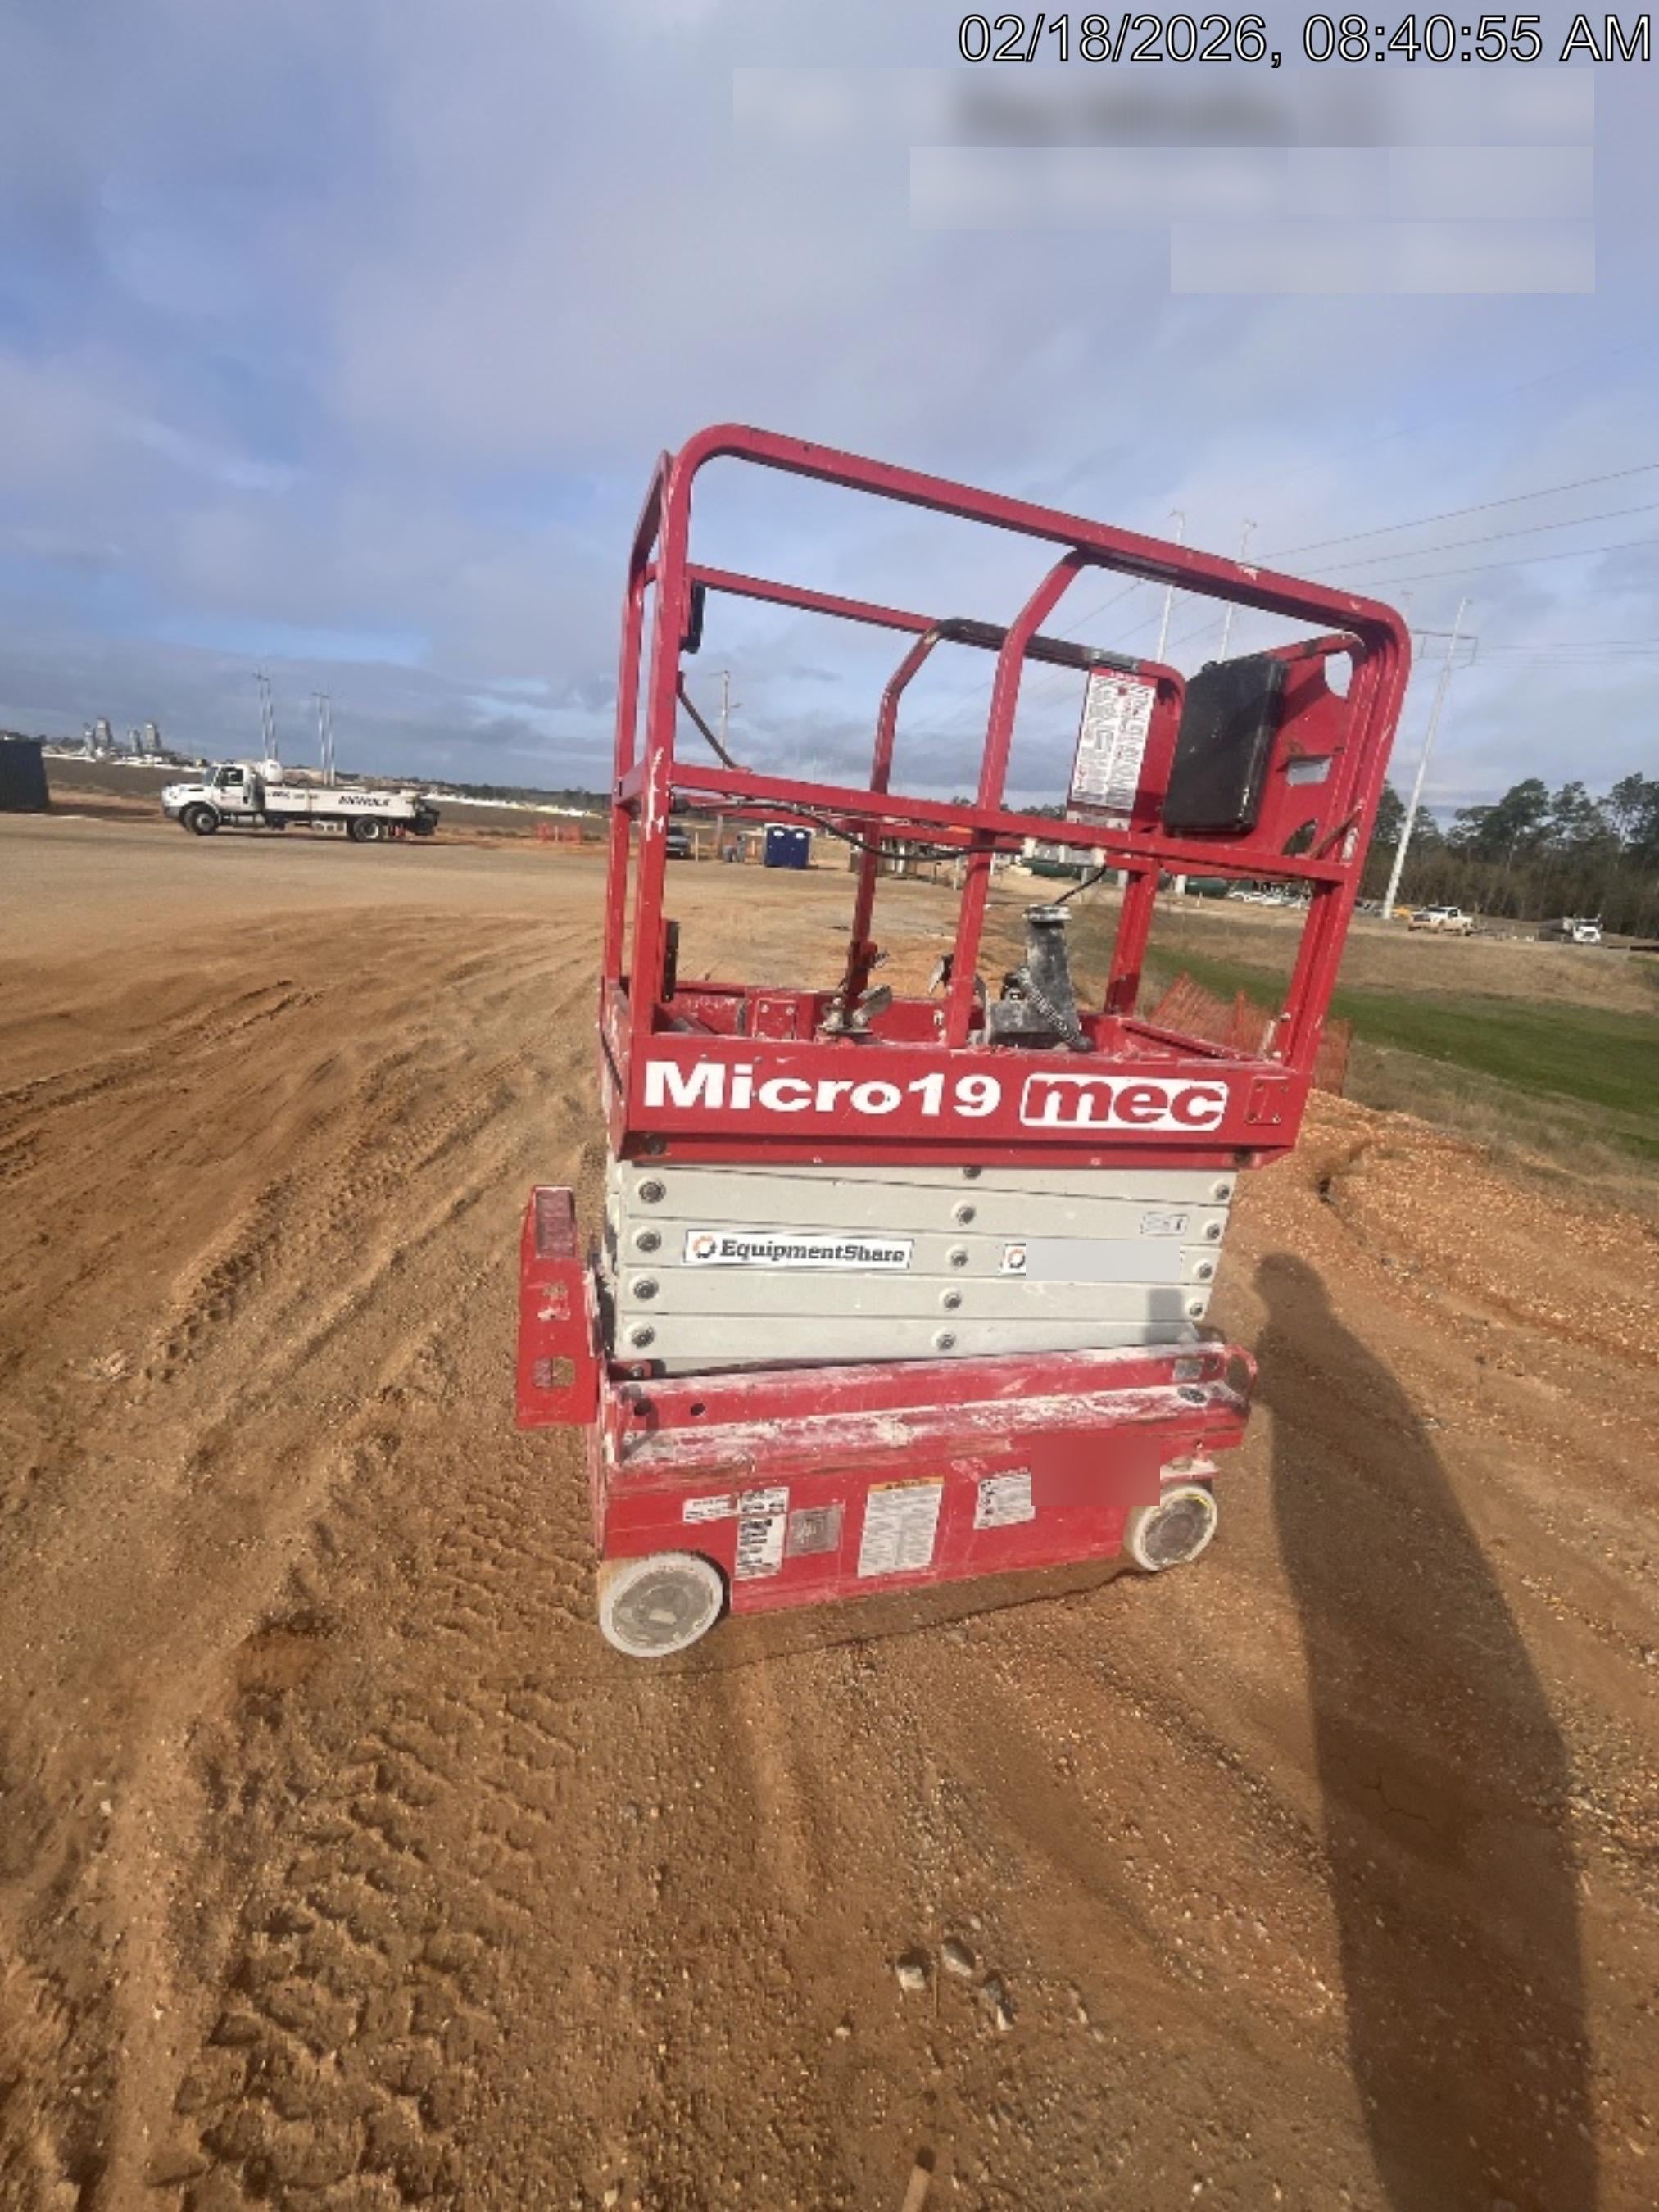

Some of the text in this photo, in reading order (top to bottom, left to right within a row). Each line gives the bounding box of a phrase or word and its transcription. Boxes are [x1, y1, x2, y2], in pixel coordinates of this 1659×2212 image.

[644, 1059, 1225, 1126] Micro19 mec
[719, 1222, 906, 1262] EquipmentShare
